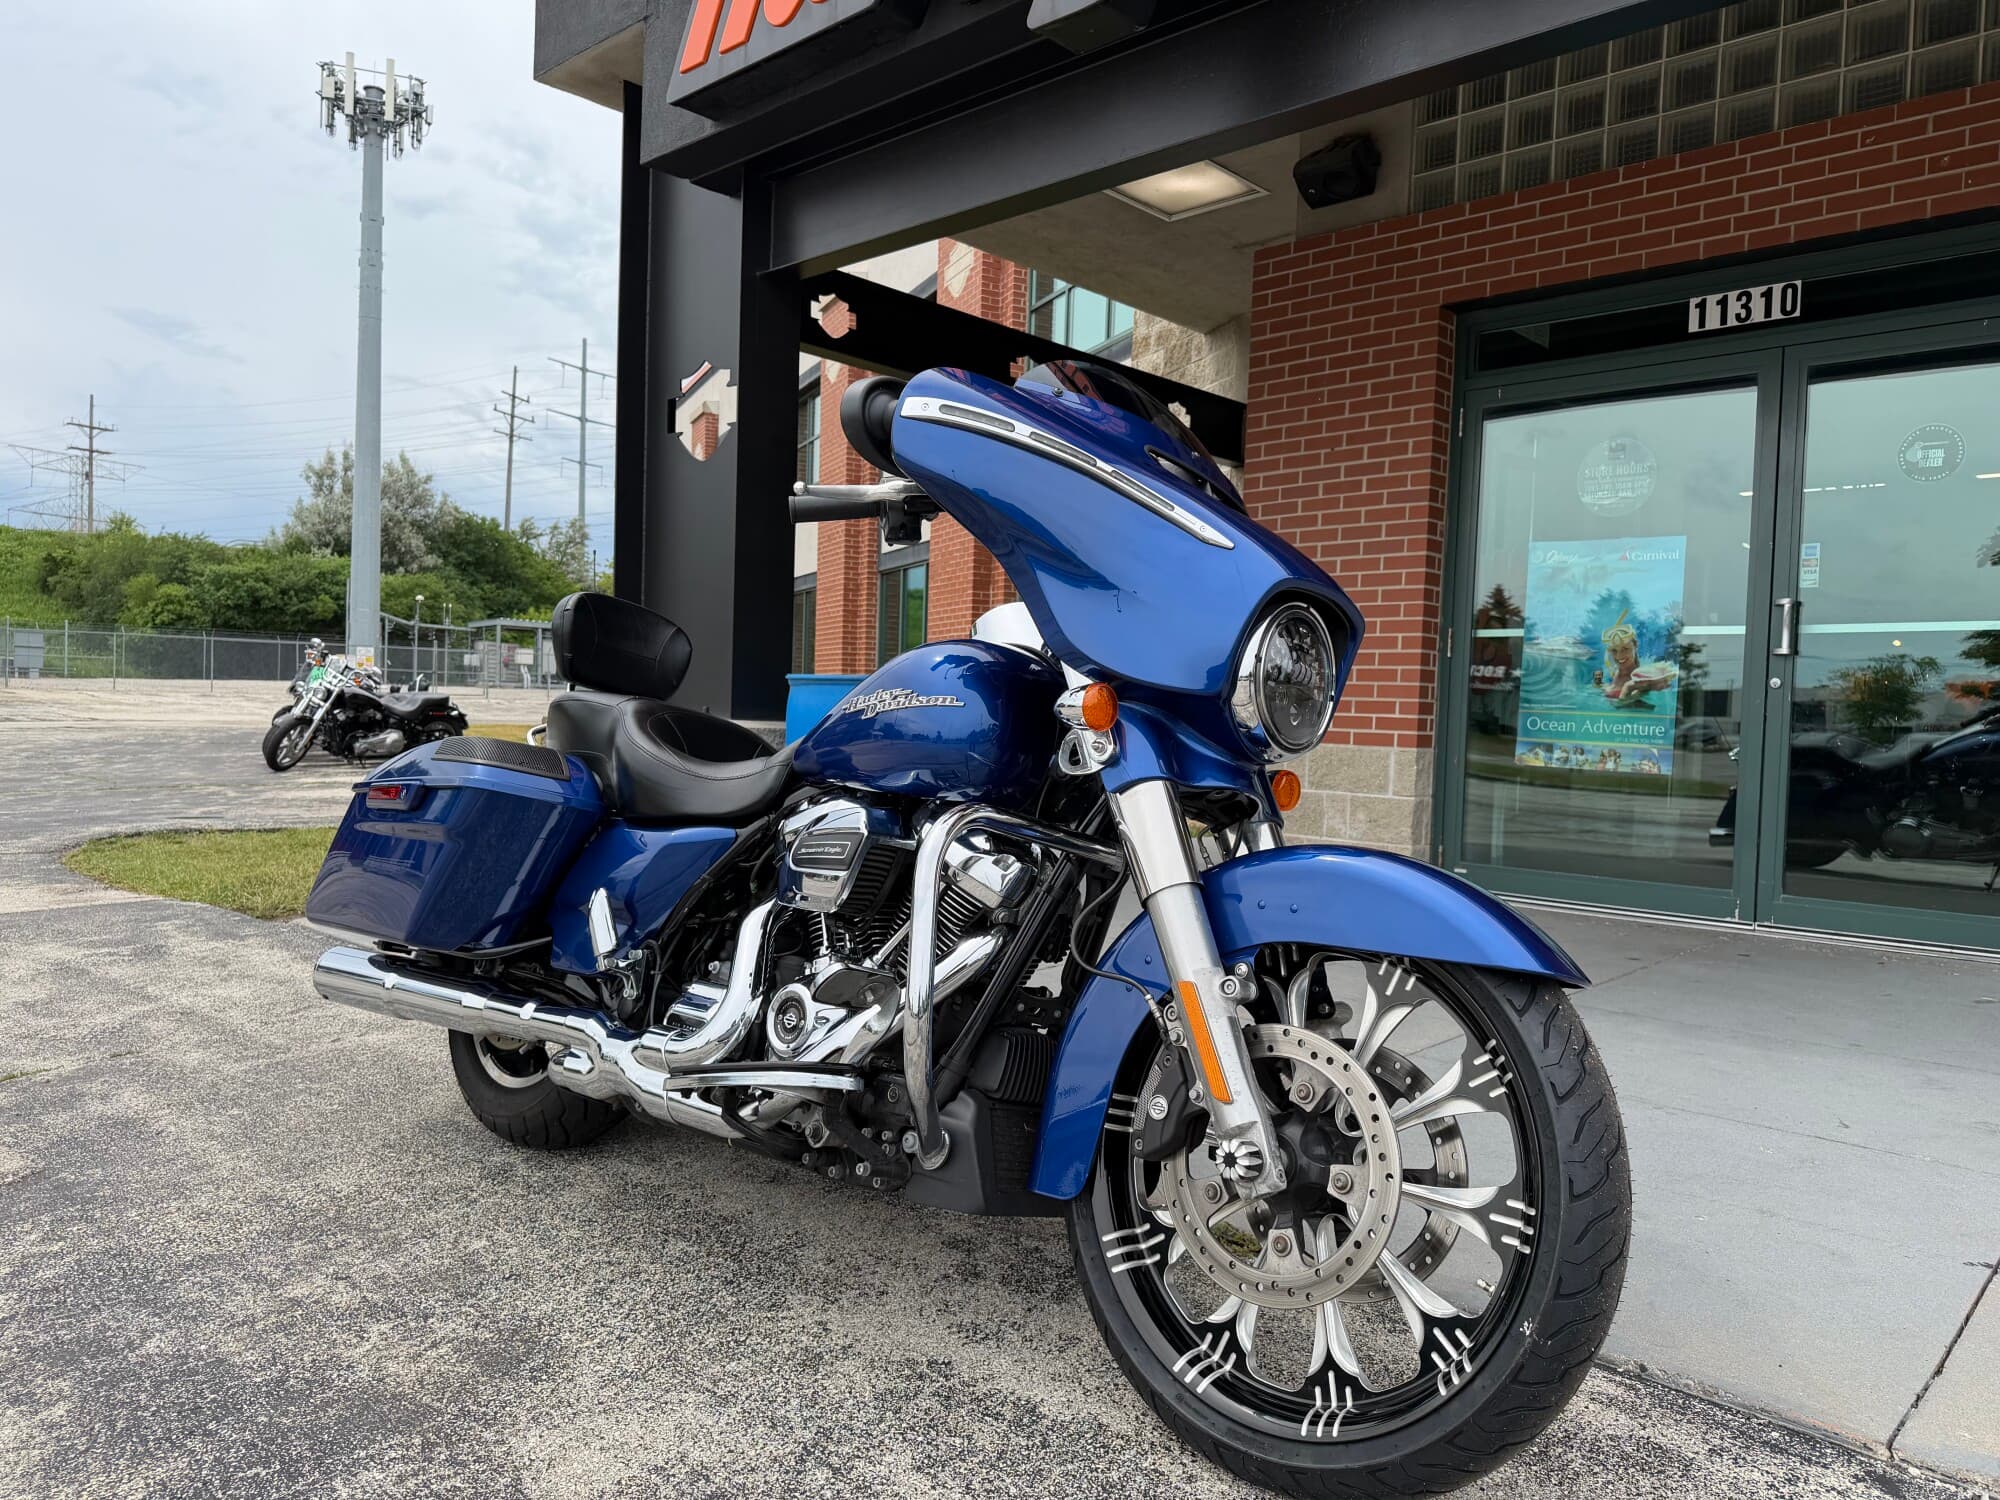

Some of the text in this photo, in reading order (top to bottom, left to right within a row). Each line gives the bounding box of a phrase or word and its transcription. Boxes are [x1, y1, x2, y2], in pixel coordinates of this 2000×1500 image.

[1694, 283, 1799, 330] 11310
[1917, 447, 1946, 460] OFFICIAL
[1616, 462, 1649, 476] HOURS
[1918, 457, 1944, 469] DEALER
[1631, 549, 1680, 562] Carnival
[861, 694, 965, 720] Davidson
[1526, 716, 1665, 738] Ocean Adventure
